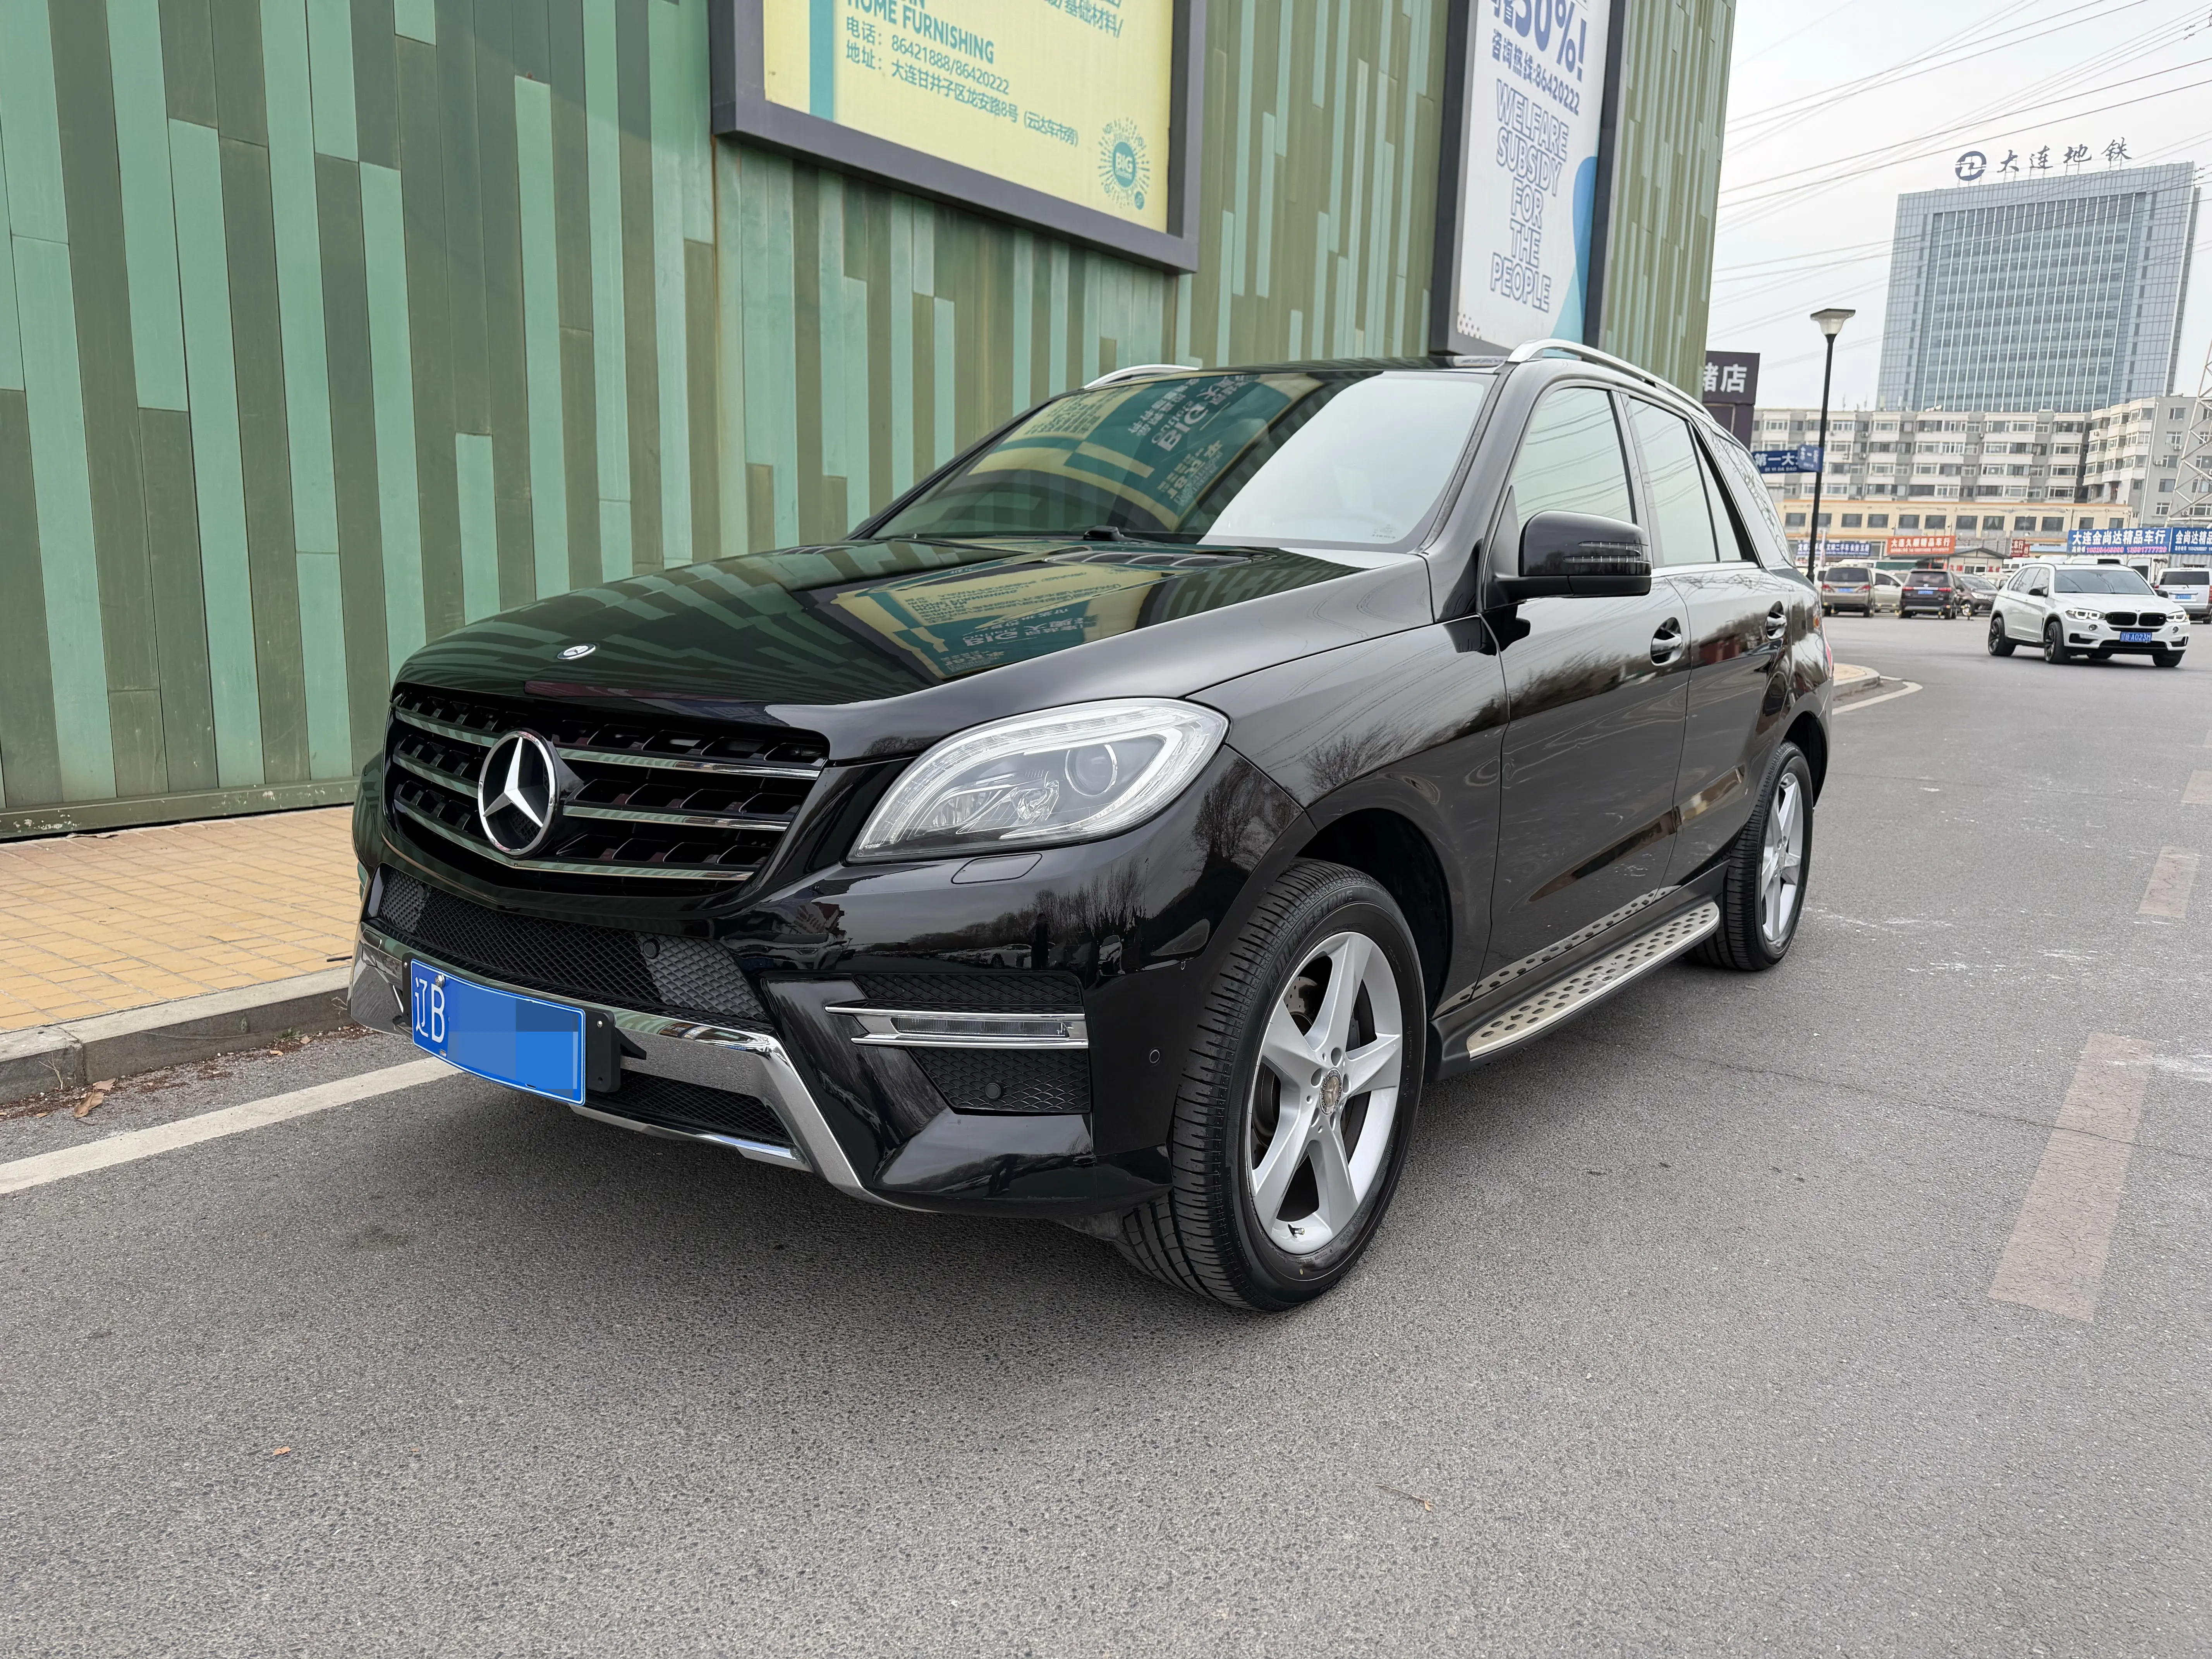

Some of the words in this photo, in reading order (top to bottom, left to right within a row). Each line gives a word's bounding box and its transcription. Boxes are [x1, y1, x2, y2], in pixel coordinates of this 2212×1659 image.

[892, 34, 1010, 95] 86421888/86420222
[903, 5, 994, 64] FURNISHING
[1496, 79, 1569, 162] WELFARE
[1496, 127, 1563, 196] SUBSIDY
[1997, 136, 2132, 173] 大连地铁
[1511, 179, 1544, 229] FOR
[1510, 220, 1541, 269] THE
[1491, 252, 1551, 313] PEOPLE
